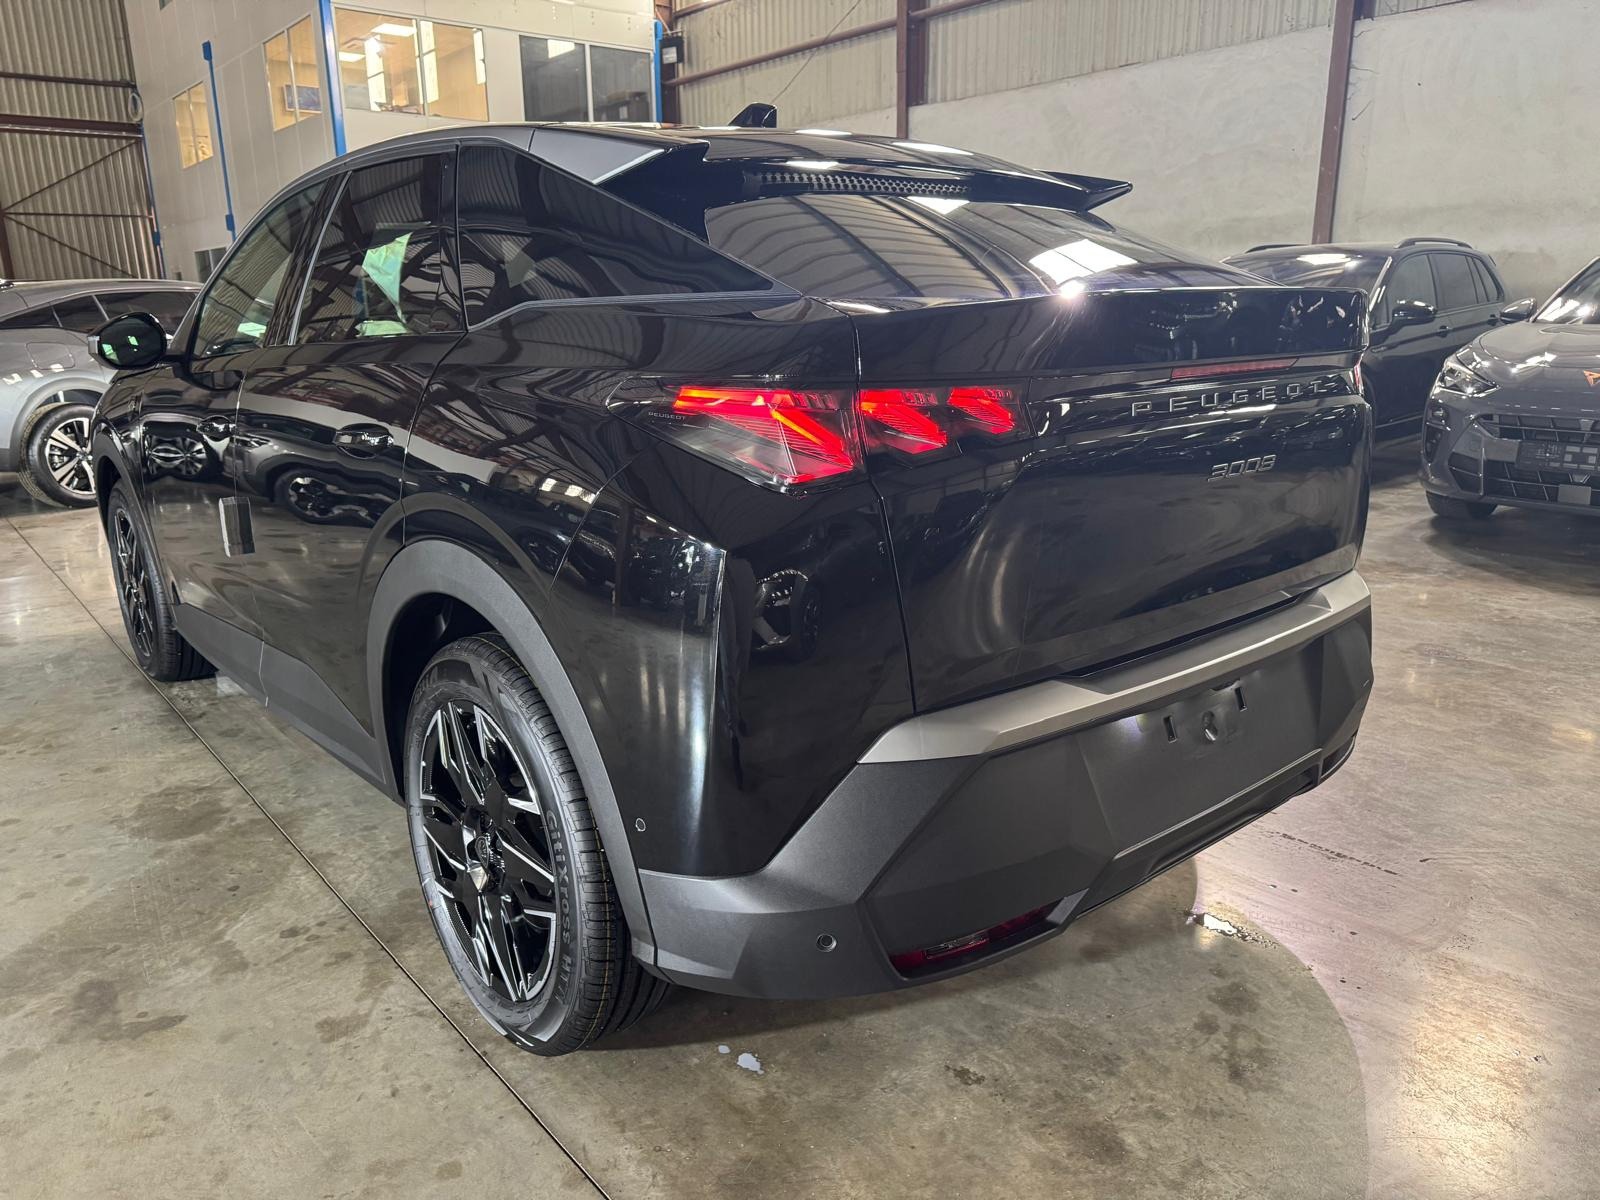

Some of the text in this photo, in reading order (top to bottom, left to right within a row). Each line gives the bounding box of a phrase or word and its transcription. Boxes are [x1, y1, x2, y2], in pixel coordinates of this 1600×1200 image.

[1131, 380, 1328, 417] PEUGEOT
[648, 411, 685, 421] PEUGEOT
[1207, 454, 1277, 482] 3008
